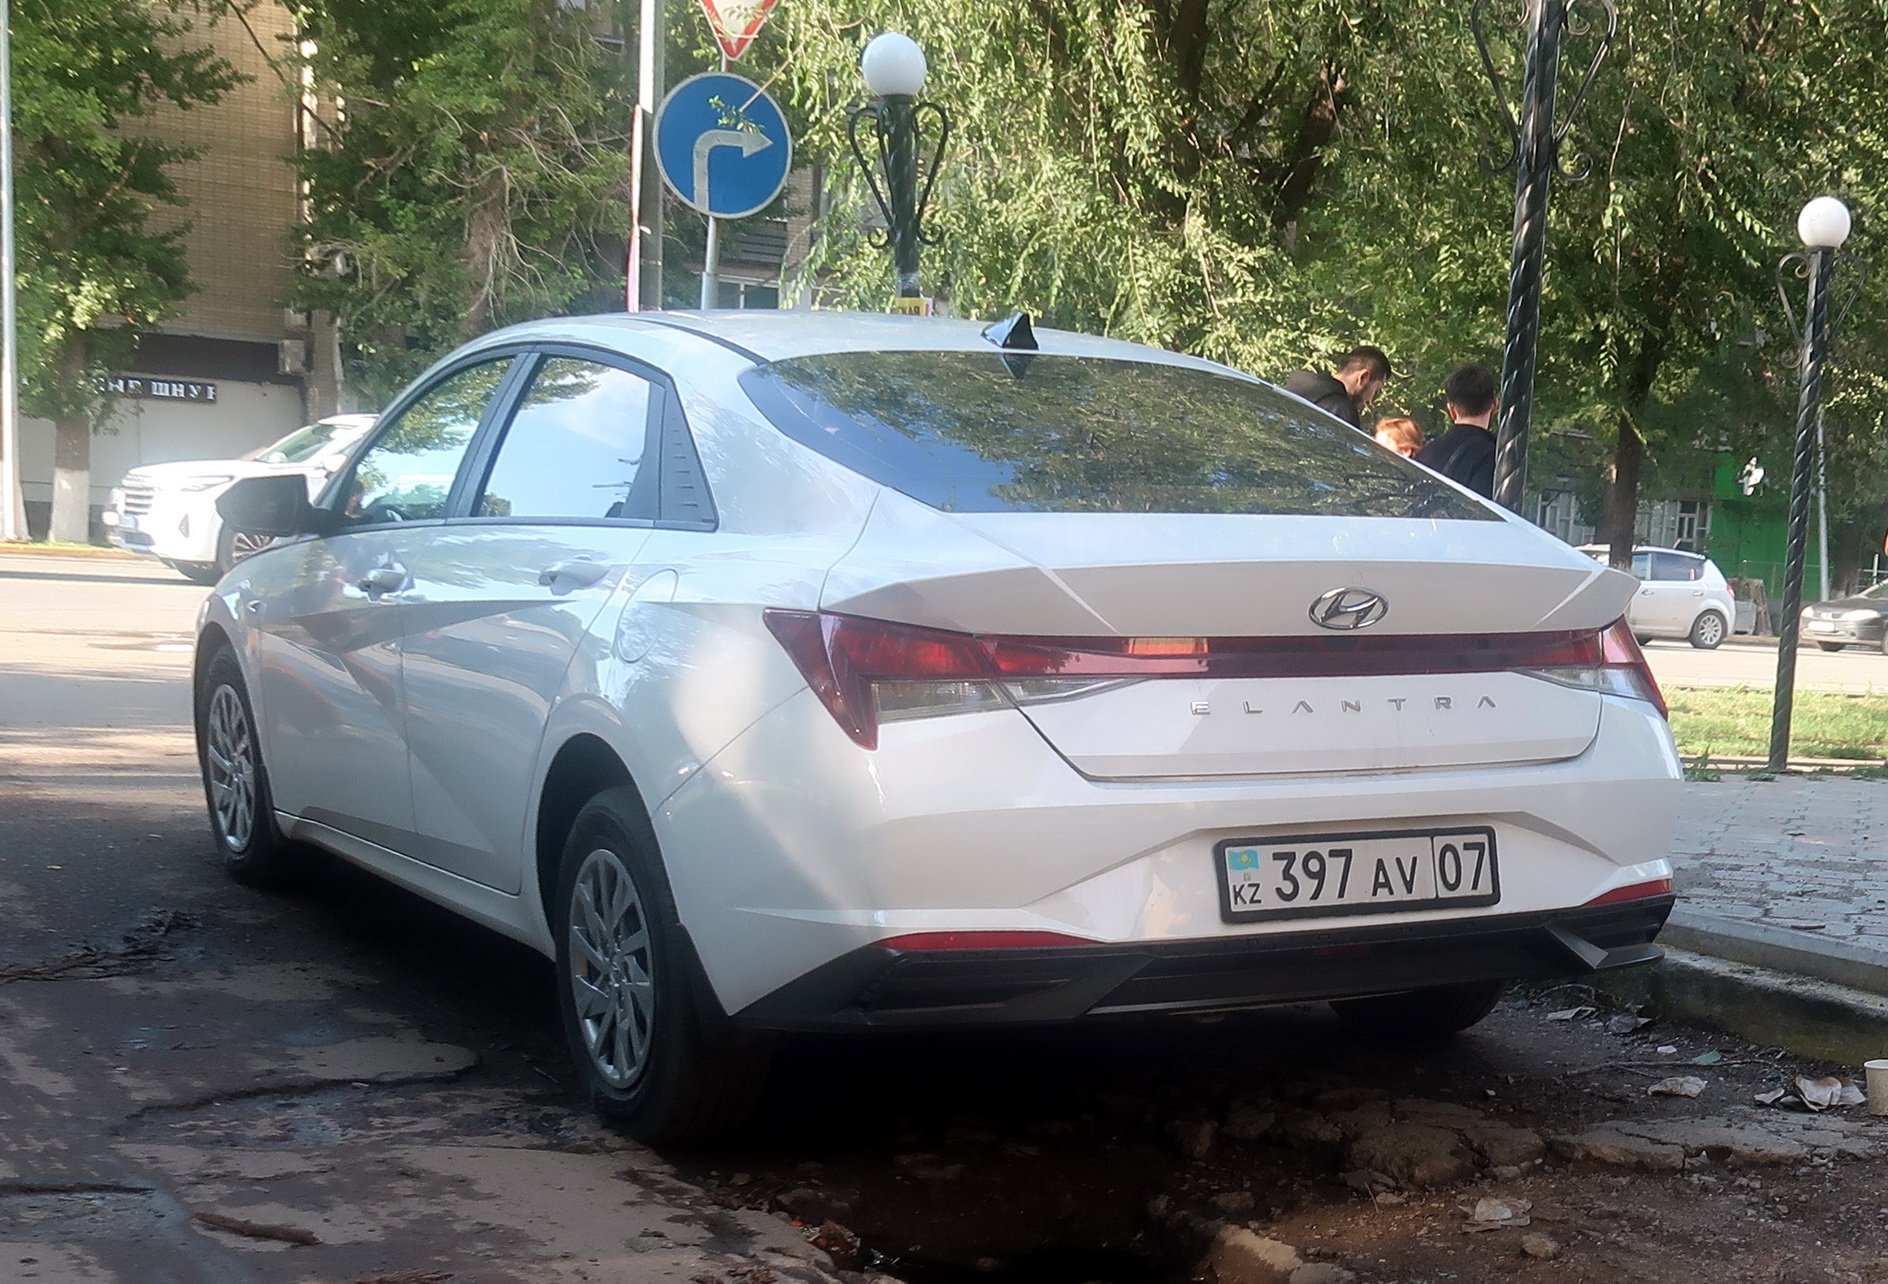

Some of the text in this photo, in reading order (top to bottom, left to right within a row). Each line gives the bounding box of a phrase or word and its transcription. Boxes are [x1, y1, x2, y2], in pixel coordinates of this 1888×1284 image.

[1190, 695, 1496, 715] ELANTRA
[1272, 842, 1486, 902] 397 AV 07
[1232, 883, 1262, 906] KZ
